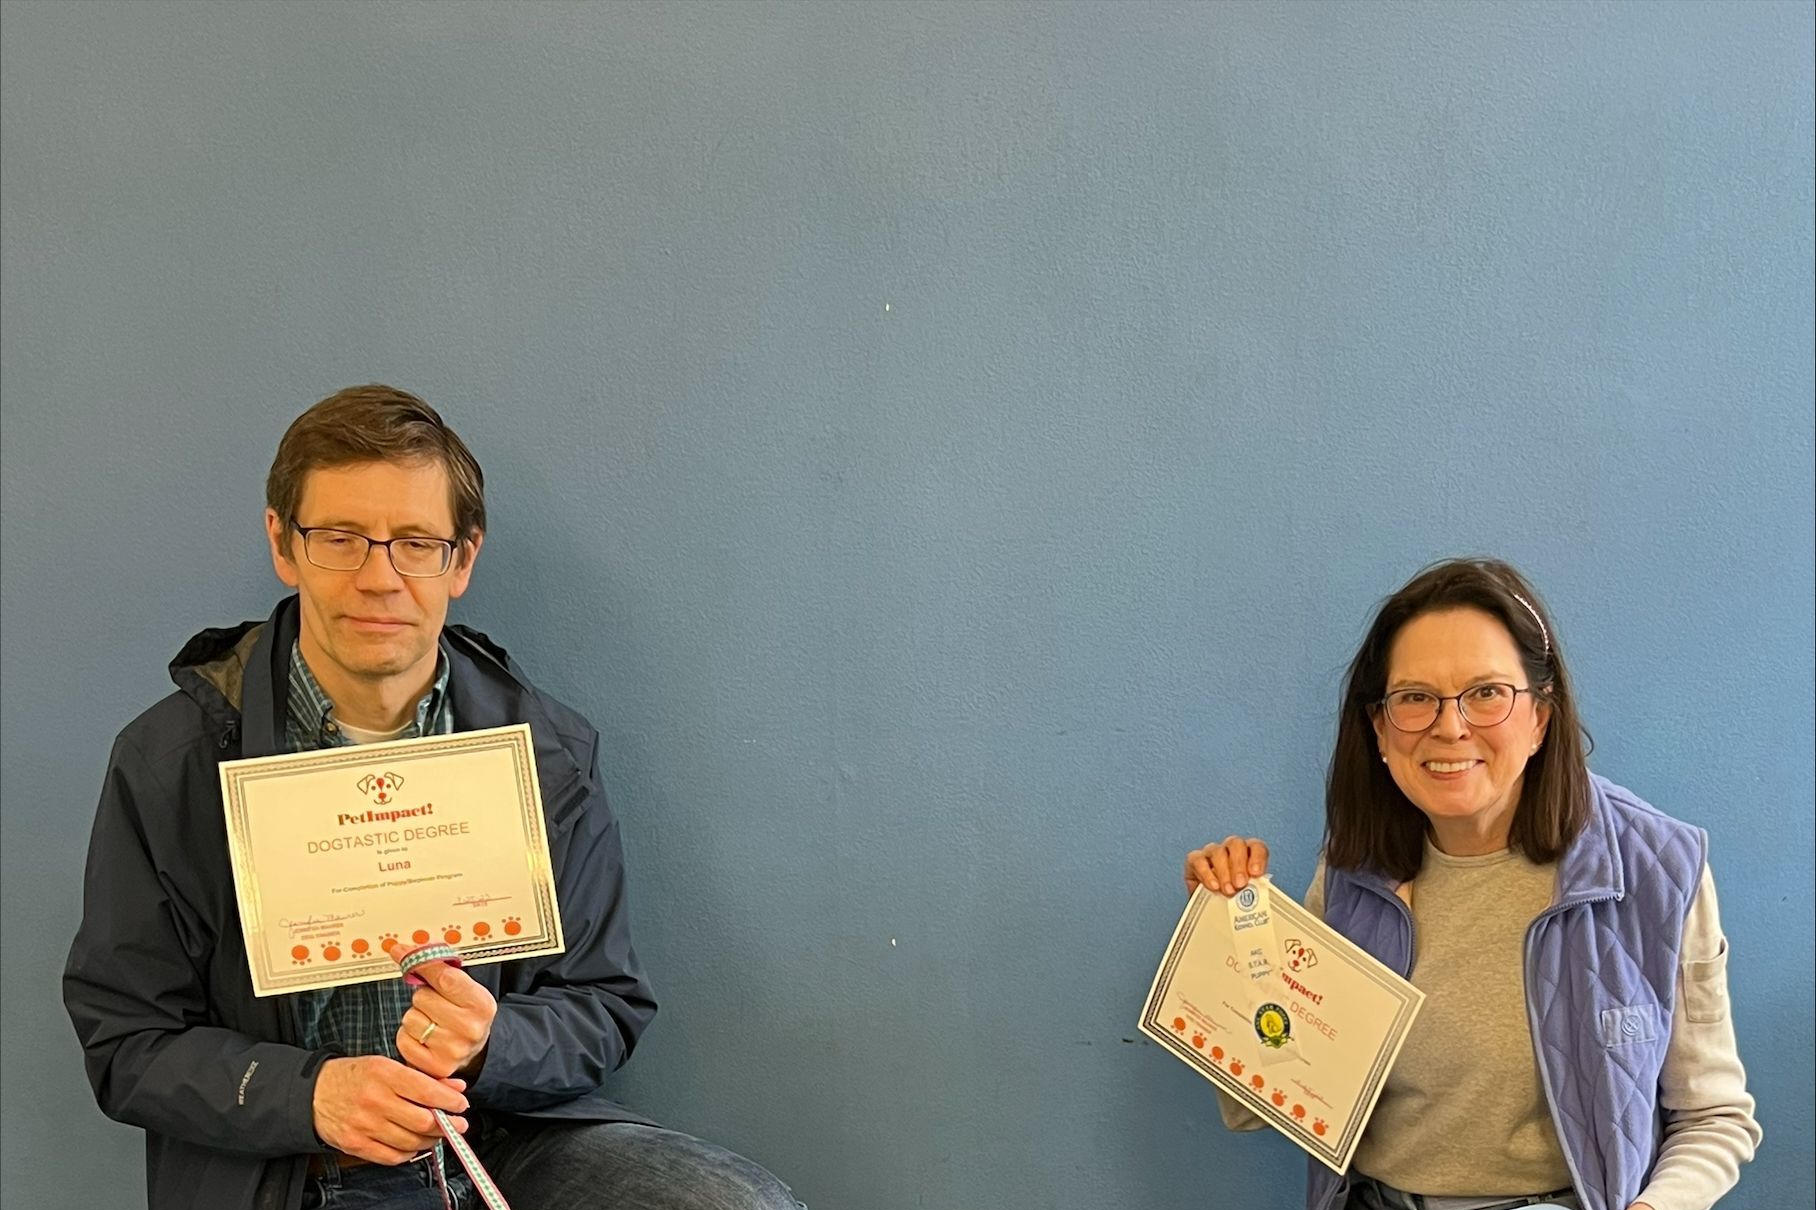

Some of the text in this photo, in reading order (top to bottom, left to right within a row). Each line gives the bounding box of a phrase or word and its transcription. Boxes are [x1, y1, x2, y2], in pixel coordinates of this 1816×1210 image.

[337, 803, 433, 825] PetImpact!
[307, 821, 470, 854] DOGTASTIC DEGREE
[378, 860, 411, 872] Luna
[1281, 972, 1324, 1006] mpact!
[1289, 1000, 1338, 1041] DEGREE
